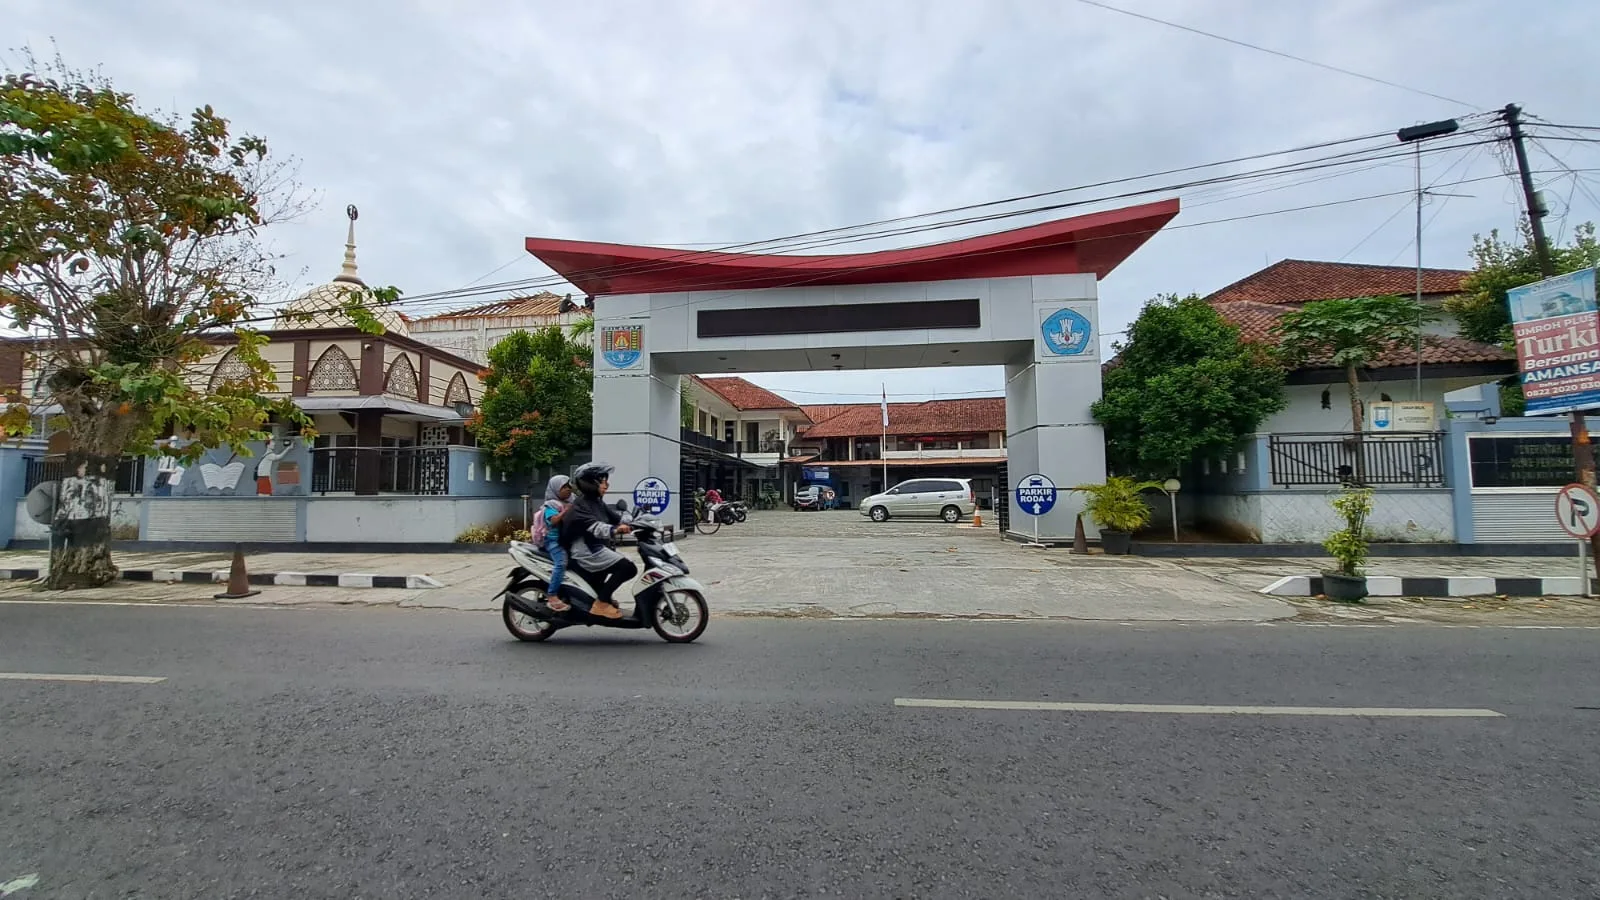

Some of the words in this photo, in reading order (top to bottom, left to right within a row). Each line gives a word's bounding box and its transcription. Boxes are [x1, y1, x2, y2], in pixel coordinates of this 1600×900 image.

[1516, 321, 1561, 337] UMROH
[1564, 313, 1597, 327] PLUS
[1517, 321, 1599, 358] Turki
[1524, 349, 1600, 370] Bersama
[1552, 384, 1577, 394] 2020
[1569, 498, 1590, 527] P
